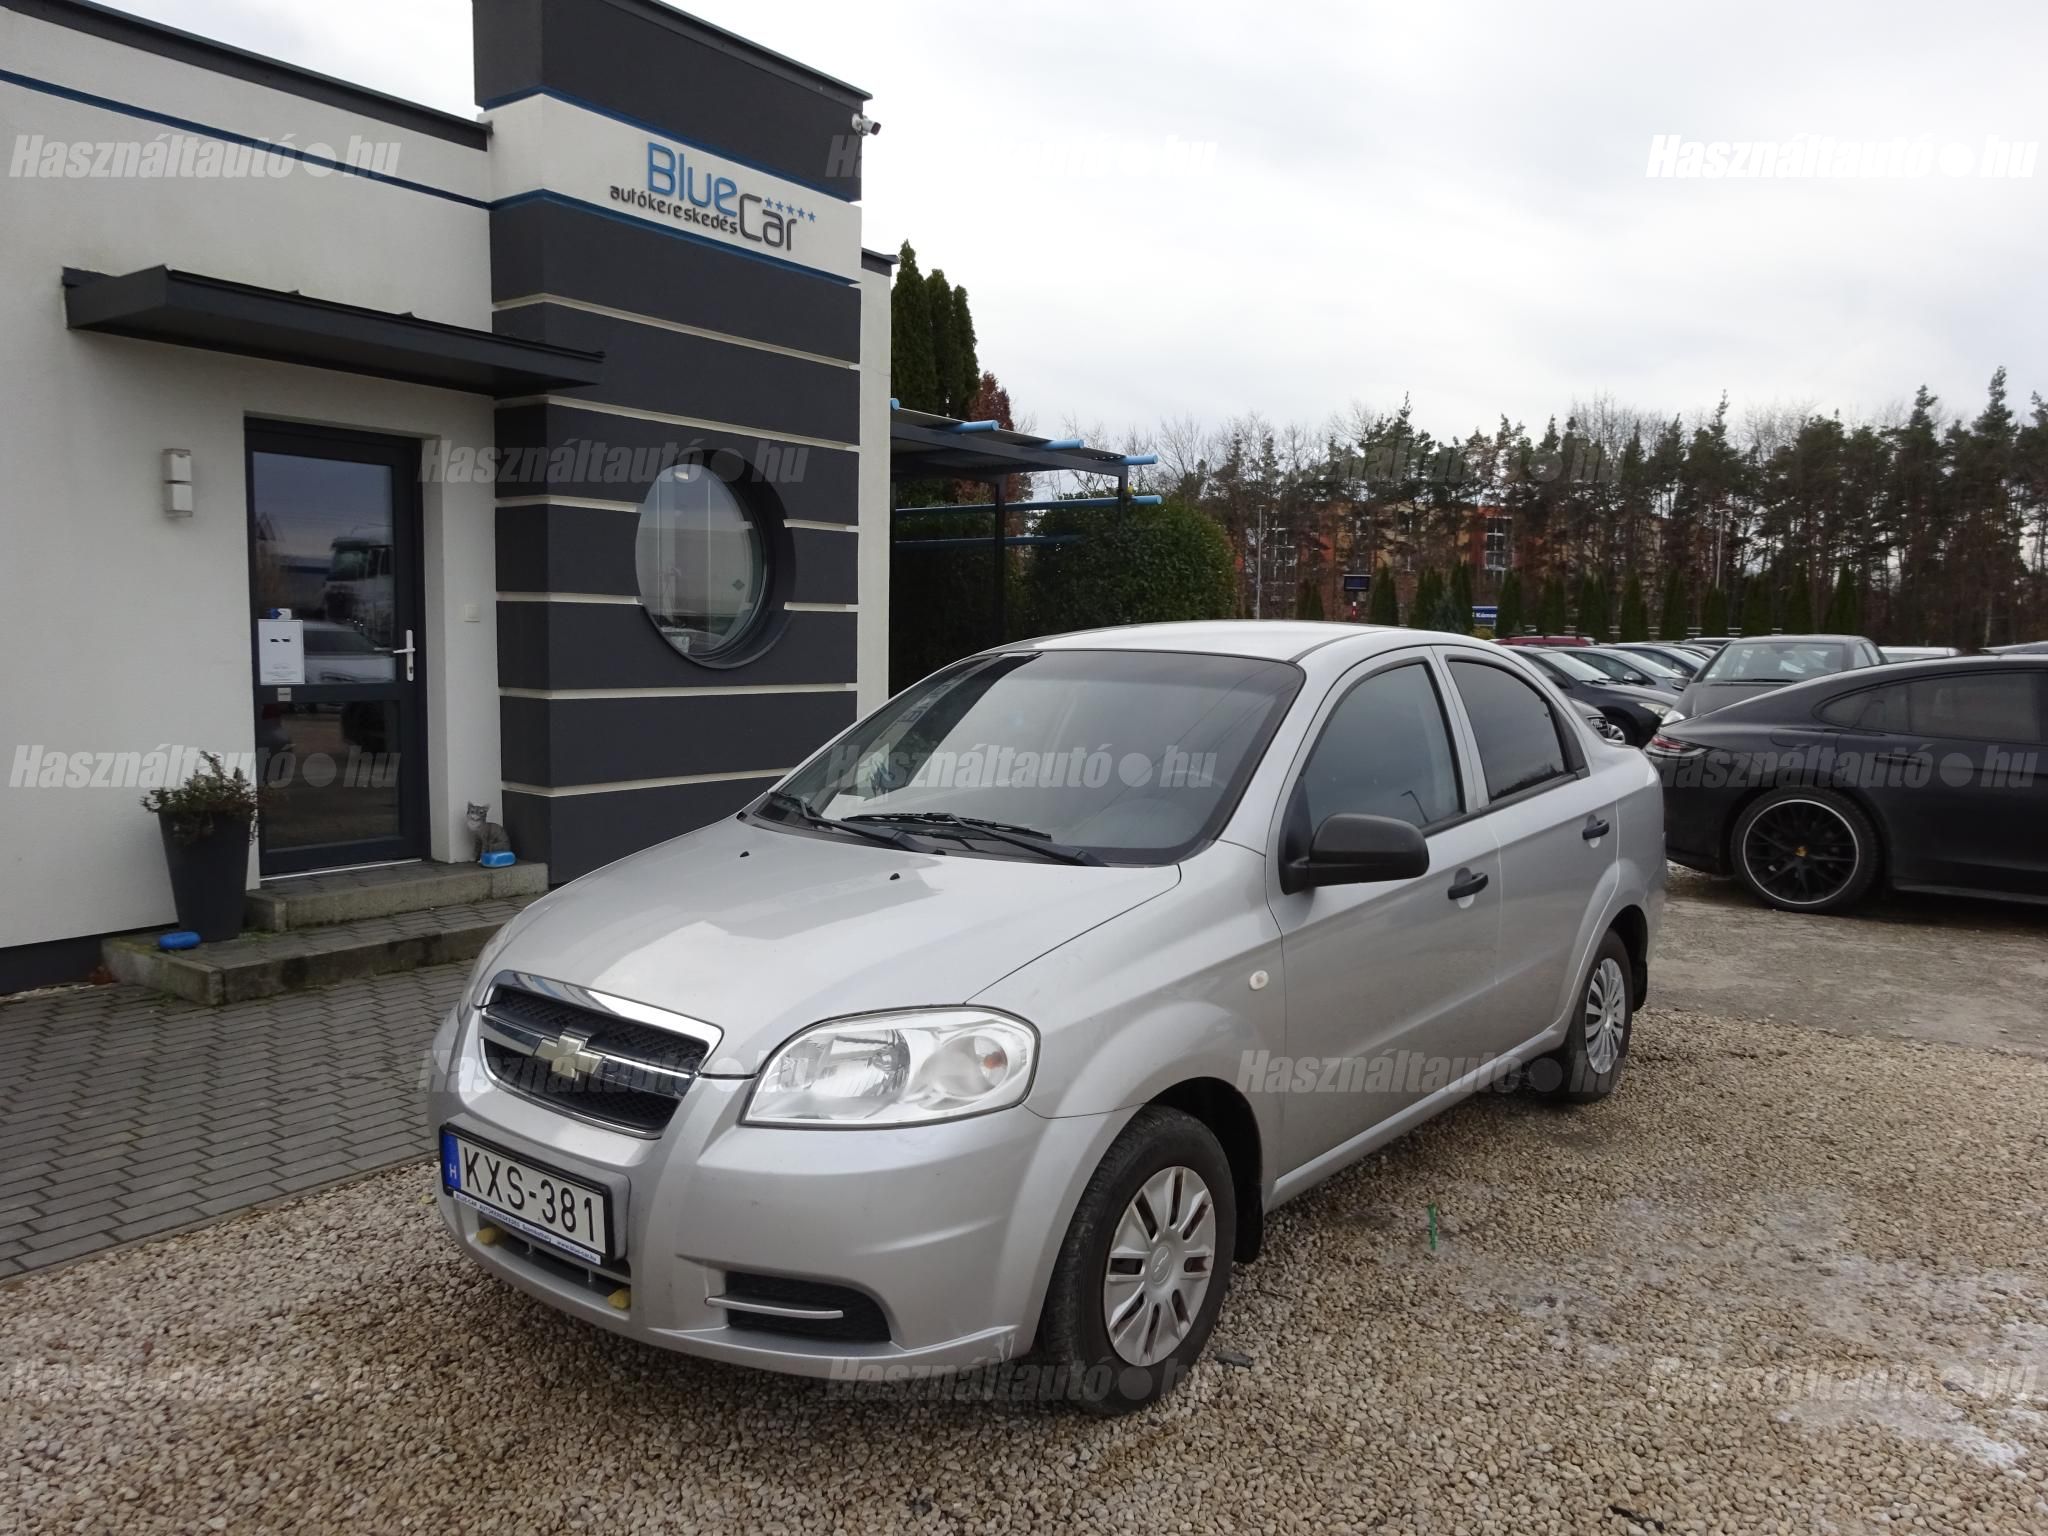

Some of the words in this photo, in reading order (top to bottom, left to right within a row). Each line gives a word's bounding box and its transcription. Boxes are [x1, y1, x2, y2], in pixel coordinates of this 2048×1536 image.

[610, 186, 738, 234] autókereskedés
[449, 1163, 457, 1180] H
[464, 1147, 594, 1242] KXS-381
